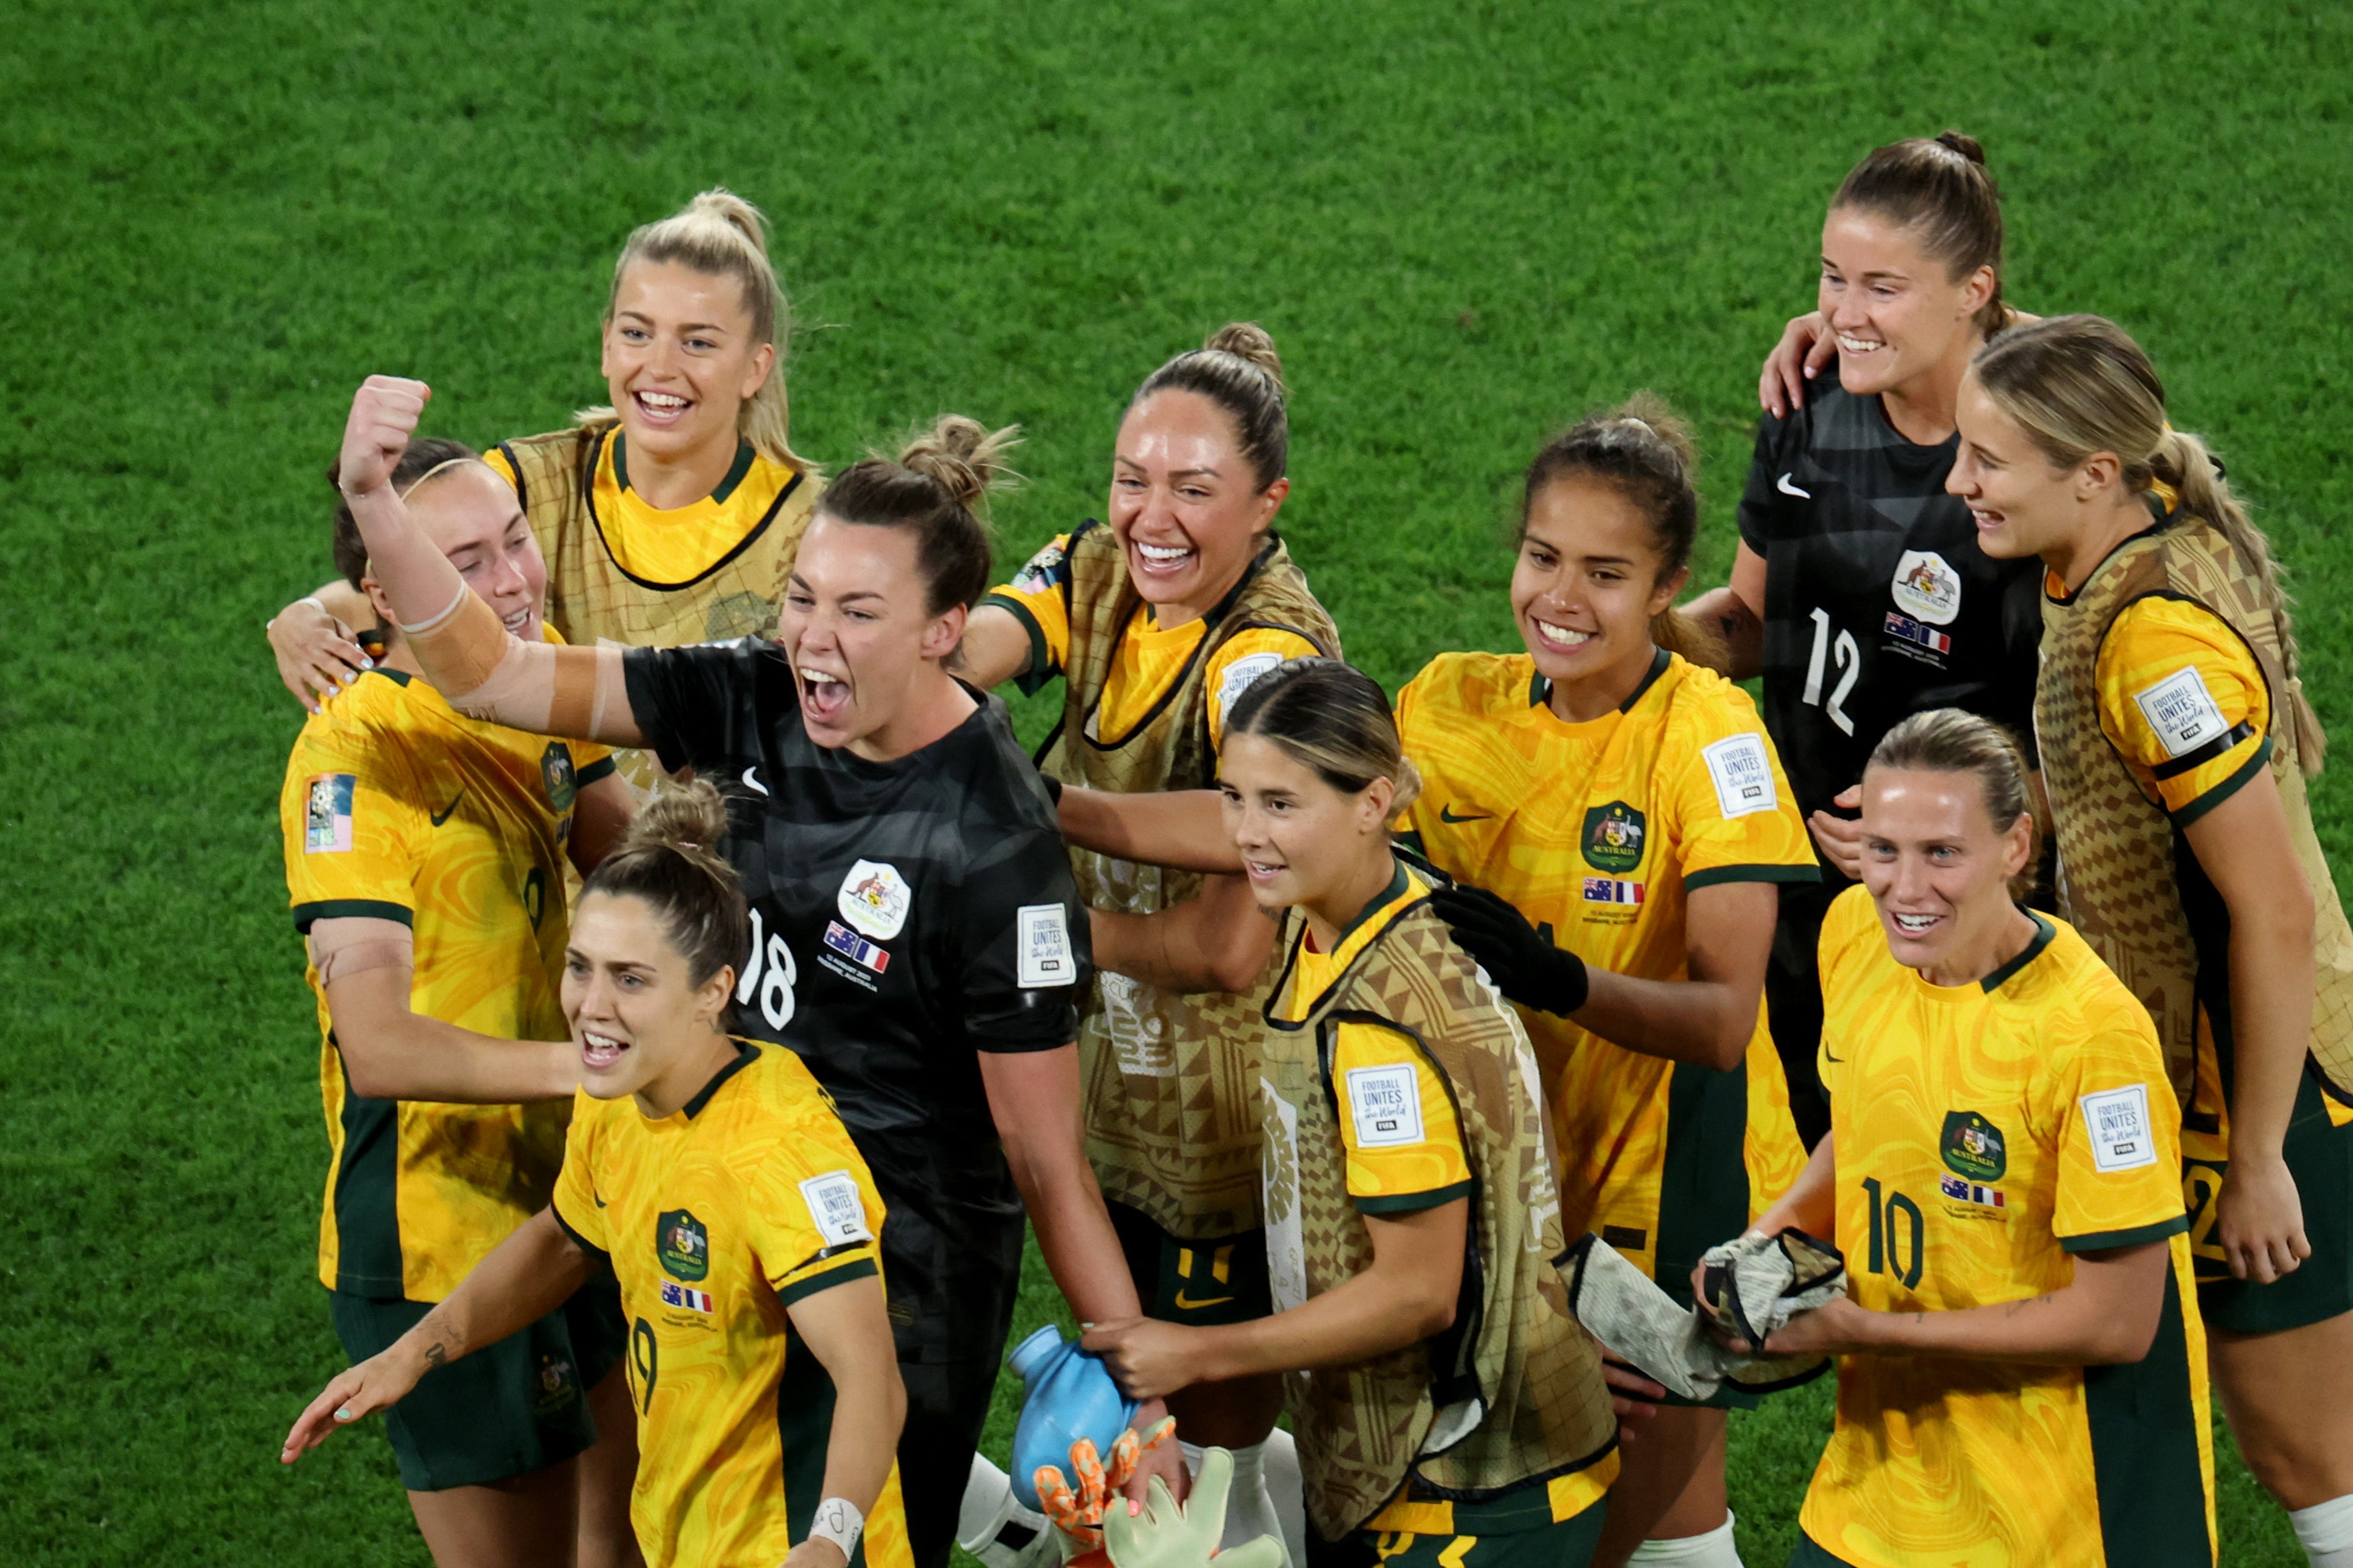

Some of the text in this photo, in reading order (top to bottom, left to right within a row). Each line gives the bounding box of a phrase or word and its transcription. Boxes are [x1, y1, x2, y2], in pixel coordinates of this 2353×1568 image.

[1231, 665, 1266, 677] OOTBALL
[1802, 607, 1860, 737] 12
[1228, 676, 1257, 691] UNIT
[2152, 685, 2189, 710] FOOTBALL
[2158, 694, 2196, 722] UNITES
[2165, 705, 2204, 734] the World
[2181, 724, 2201, 740] FIFA
[1721, 747, 1756, 763] FOOTBALL
[1725, 757, 1761, 775] UNITES
[1033, 930, 1061, 945] UNITES
[736, 907, 797, 1031] 18
[1362, 1078, 1400, 1091] FOOTBALL
[1364, 1089, 1402, 1106] UNITES
[1379, 1103, 1405, 1117] World
[2097, 1101, 2134, 1117] FOOTBALL
[1377, 1121, 1396, 1131] FIFA
[2100, 1111, 2137, 1130] UNITES
[2116, 1126, 2141, 1141] World
[824, 1194, 852, 1213] UNITES
[1861, 1176, 1923, 1291] 10
